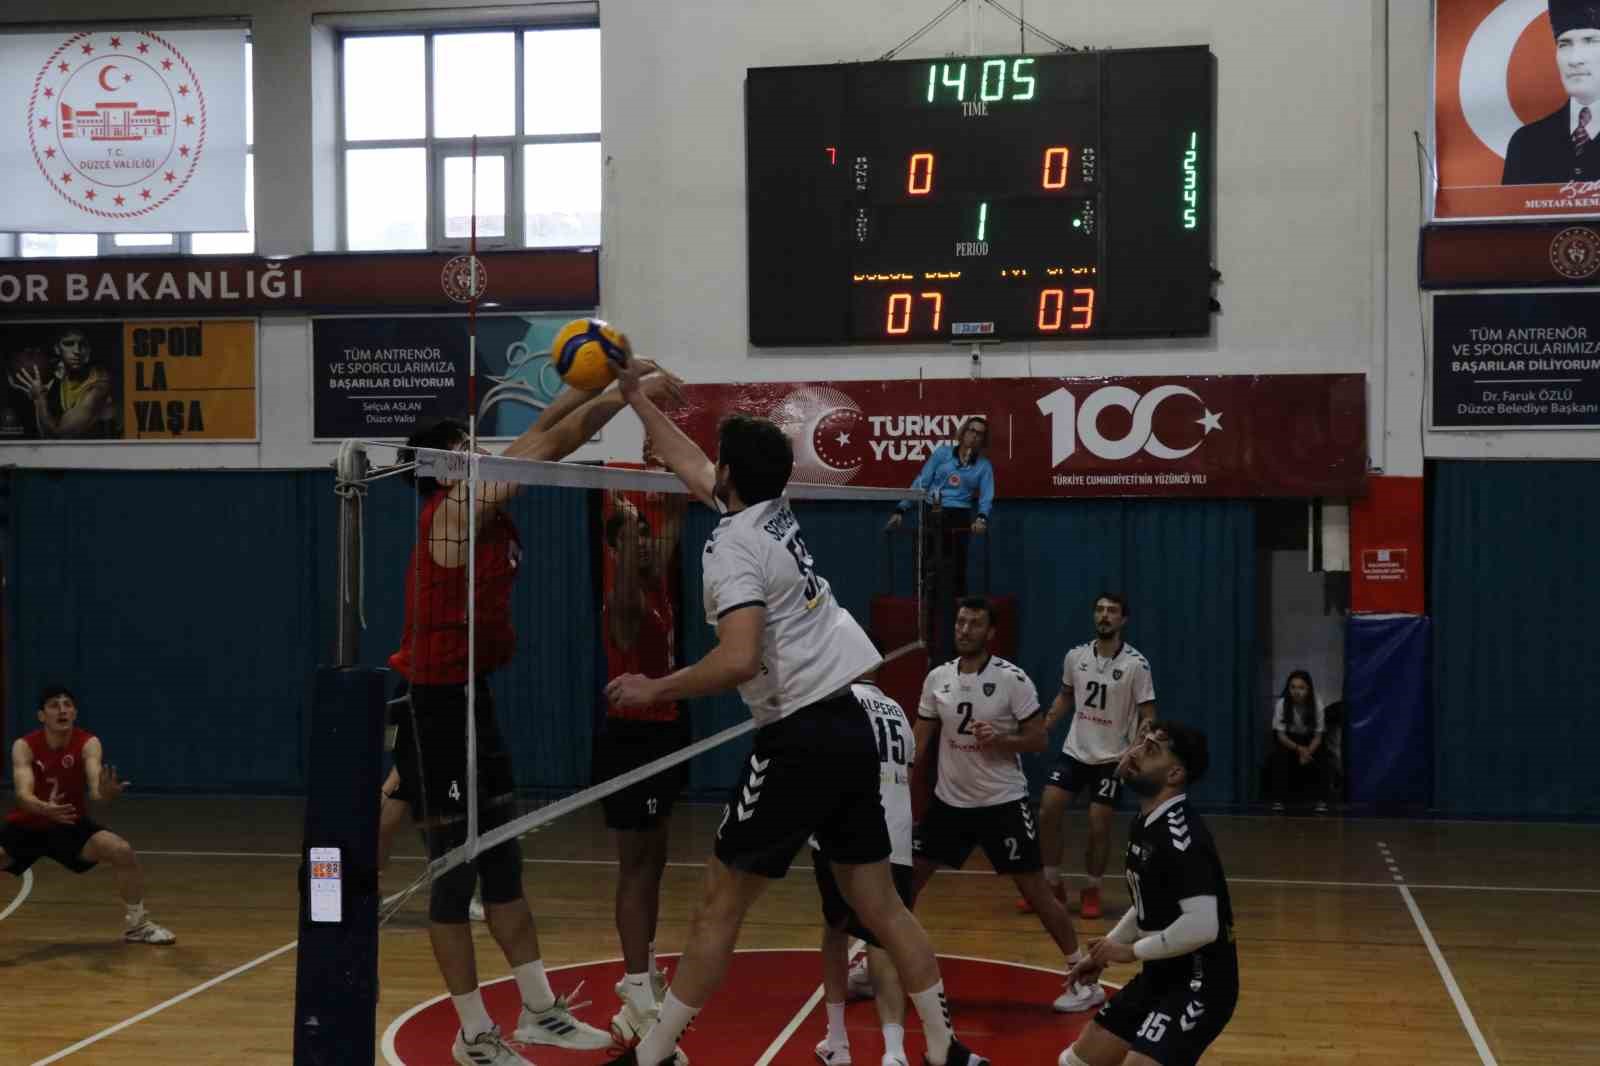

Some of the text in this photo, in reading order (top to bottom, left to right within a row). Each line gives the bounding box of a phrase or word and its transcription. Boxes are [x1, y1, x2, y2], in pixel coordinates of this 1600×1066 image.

[961, 101, 990, 118] TIME
[79, 159, 111, 170] DÜZCE
[908, 152, 935, 195] 0
[1042, 146, 1070, 190] 0
[1524, 200, 1575, 209] MUSTAFA
[977, 202, 989, 241] 1
[955, 240, 990, 258] PERIOD
[0, 263, 303, 302] OR BAKANLIĞI
[887, 293, 943, 336] 07
[1037, 287, 1096, 333] 03
[133, 327, 202, 357] SPOR
[1470, 326, 1587, 341] TÜM ANTRENÖR
[343, 346, 441, 361] TÜM ANTRENÖR
[1452, 345, 1469, 356] VE
[329, 361, 456, 375] VE SPORCULARIMIZA
[1452, 358, 1600, 374] BAŞARILAR DİLİYORUM
[136, 361, 168, 391] LA
[329, 376, 455, 390] BAŞARILAR DİLİYORUM
[1482, 387, 1573, 401] Dr. Faruk ÖZLÜ
[363, 401, 422, 413] Selçuk ASLAN
[1457, 401, 1598, 415] Düzce Belediye Başkanı
[133, 400, 204, 436] YAŞA
[366, 414, 416, 424] Düzce Valisi
[868, 414, 987, 437] TÜRKİY
[1053, 473, 1084, 486] TÜRKİYE
[1155, 472, 1190, 484] YÜZÜNCÜ
[1192, 473, 1206, 484] YILI
[1084, 680, 1108, 711] 21
[957, 702, 974, 735] 2
[875, 716, 907, 765] 15
[448, 780, 461, 801] 4
[1098, 779, 1117, 798] 21
[1004, 838, 1020, 860] 2
